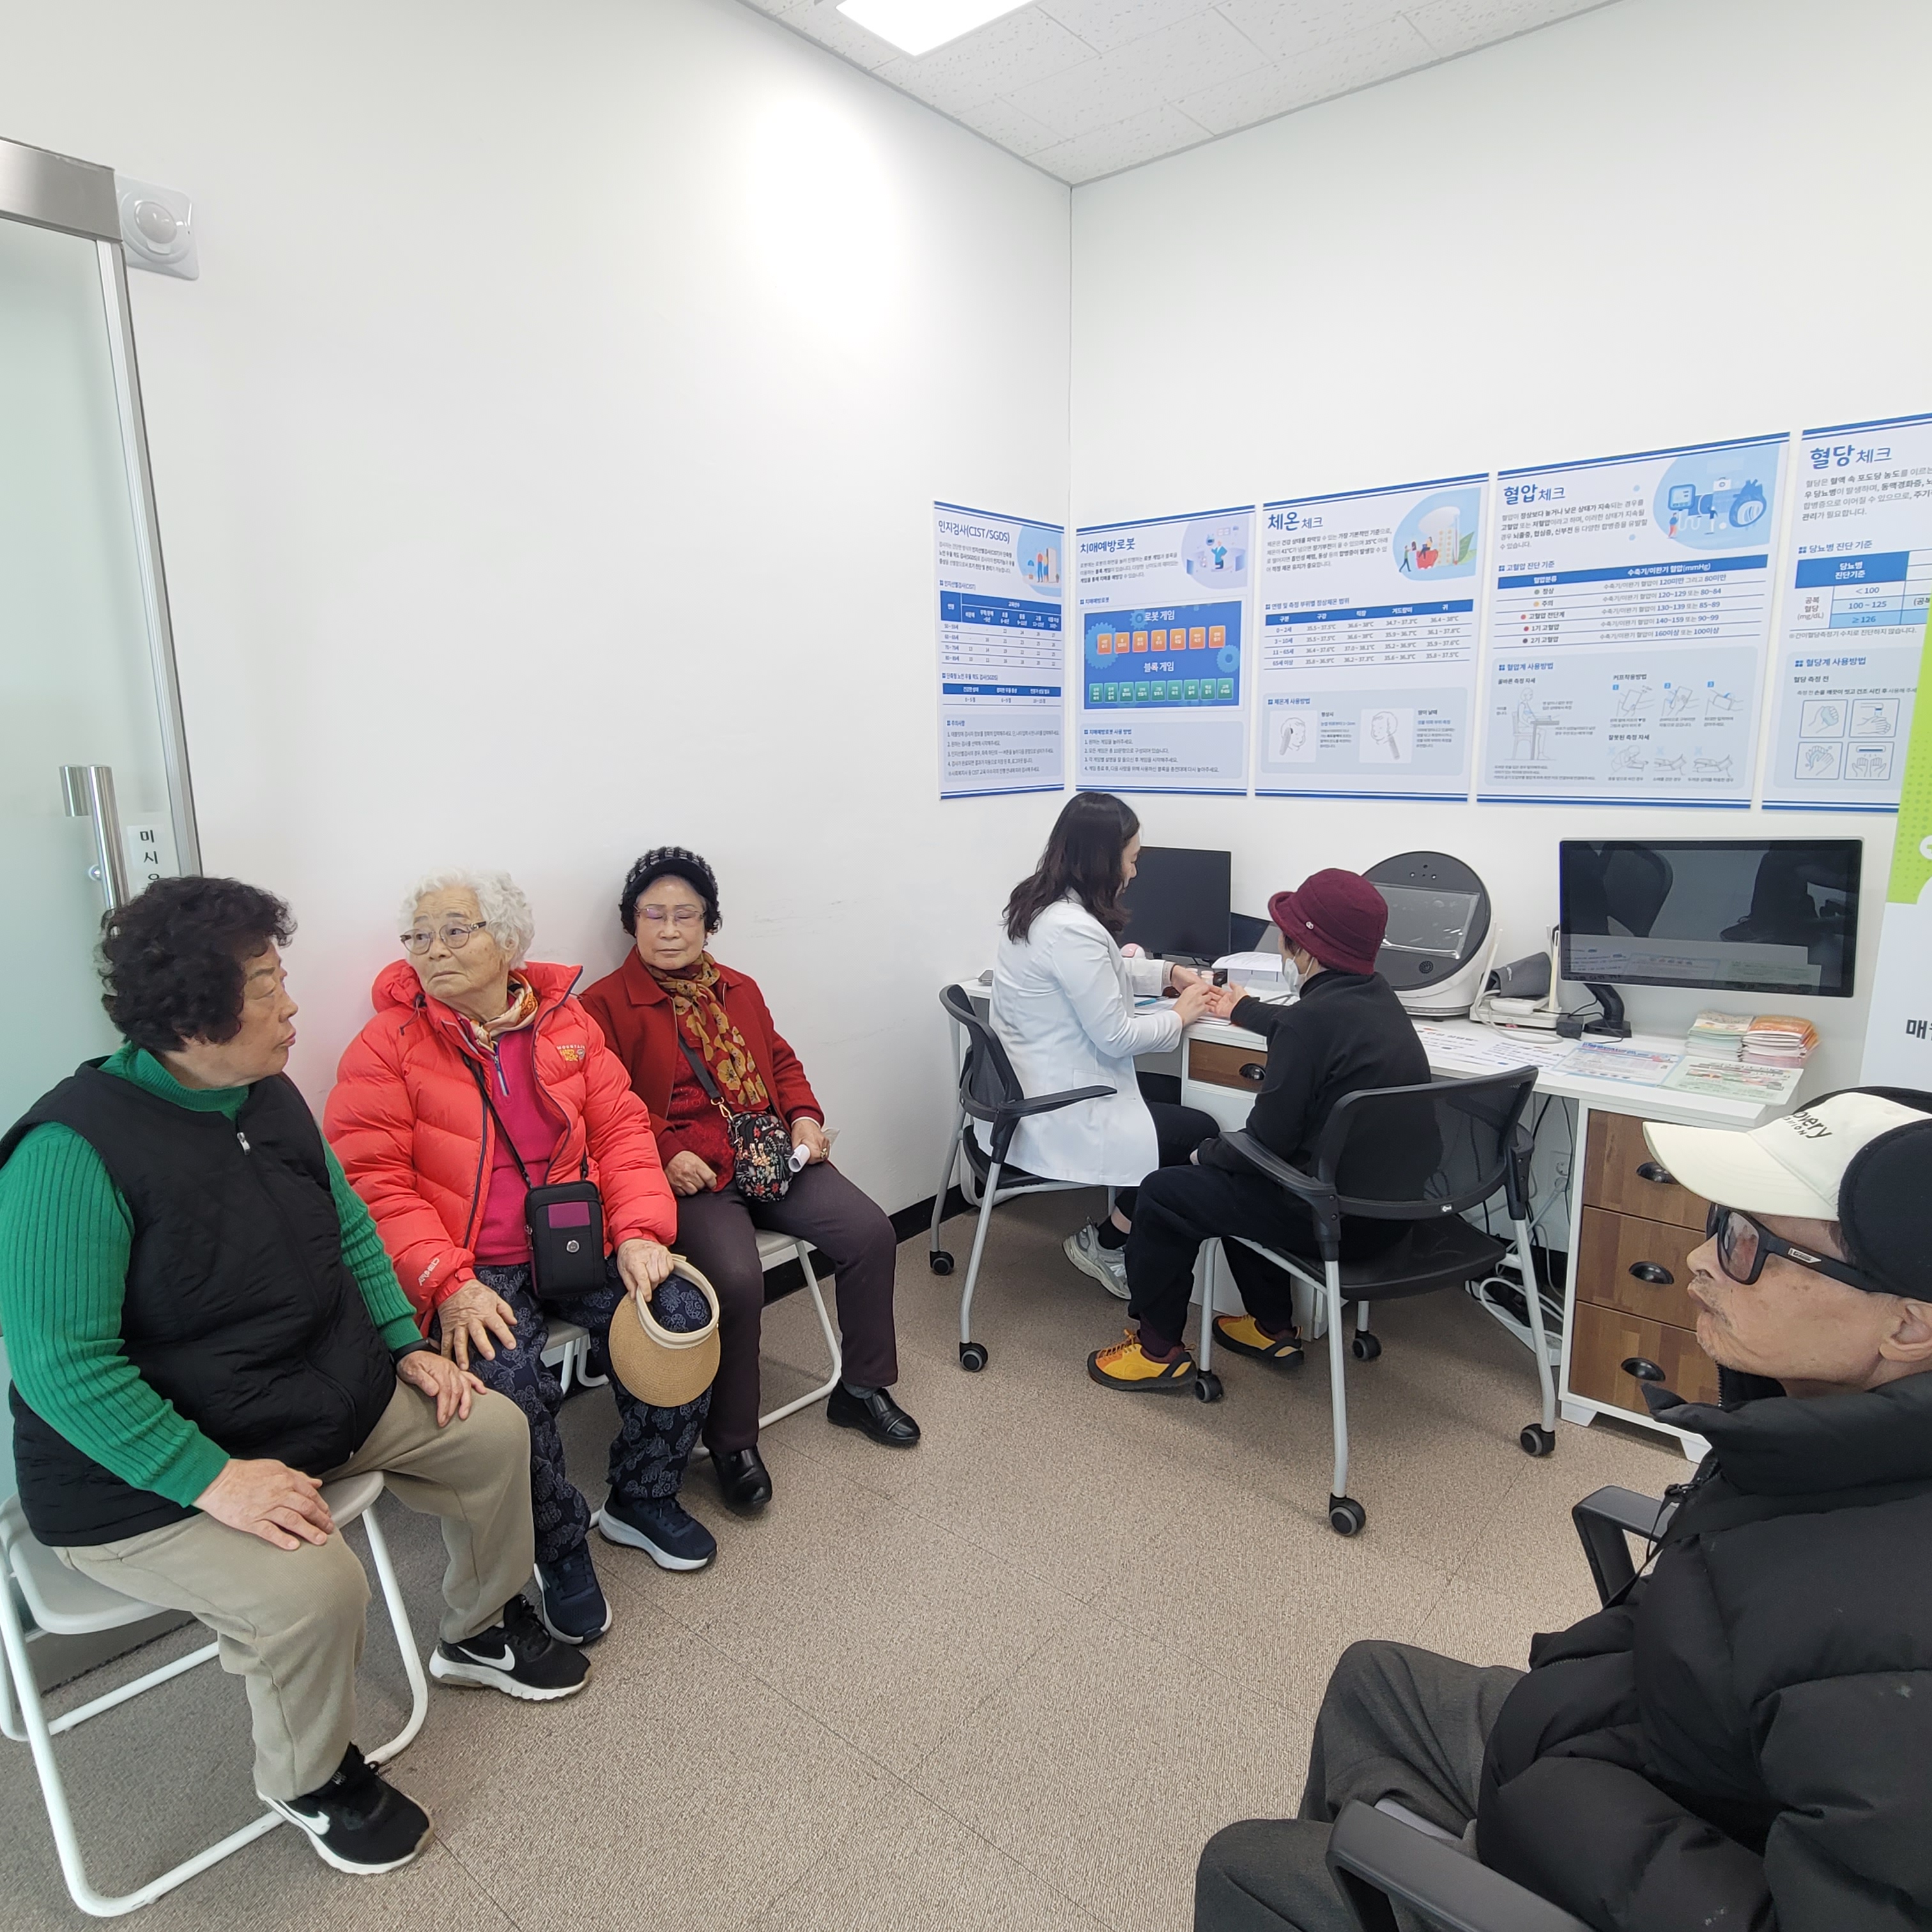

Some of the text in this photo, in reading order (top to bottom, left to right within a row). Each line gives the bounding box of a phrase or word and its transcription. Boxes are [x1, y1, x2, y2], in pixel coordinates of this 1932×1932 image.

[1811, 445, 1891, 470] 혈당 체크
[1806, 479, 1828, 488] 혈당은
[1830, 476, 1846, 485] 혈액
[1857, 472, 1882, 482] 포도당
[1884, 470, 1908, 479] 농도를
[1504, 484, 1565, 505] 혈압 체크
[1814, 488, 1844, 498] 당뇨병이
[1846, 484, 1879, 494] 발생하며,
[1882, 479, 1924, 491] 동맥경화증,
[1804, 500, 1841, 510] 합병증으로
[1843, 496, 1866, 505] 이어질
[1878, 492, 1912, 502] 있으므로,
[1521, 510, 1544, 519] 정상보다
[1545, 508, 1563, 516] 높거나
[1625, 499, 1643, 507] 경우를
[1802, 508, 1867, 521] 관리가 필요합니다.
[1267, 511, 1324, 532] 체온 체크
[1533, 518, 1568, 527] 저혈압이라고
[1605, 511, 1623, 520] 상태가
[939, 521, 1009, 544] 인지검사(CIST/SGDS)
[1080, 538, 1135, 553] 치매예방로봇
[1506, 541, 1531, 549] 있습니다.
[1809, 540, 1873, 553] 당뇨병 진단 기준
[1528, 562, 1540, 570] 진단
[1628, 564, 1710, 576] 수축기/이완기 혈압(mmHg)
[1840, 562, 1862, 571] 당뇨병
[1534, 576, 1556, 584] 혈압분류
[1705, 574, 1726, 582] 80미만
[1836, 570, 1865, 579] 진단기준
[1144, 610, 1174, 621] 로봇 게임
[1797, 612, 1824, 620] (mg/dL)
[1144, 661, 1174, 673] 블록 게임
[1806, 657, 1866, 667] 혈당계 사용방법
[1906, 1019, 1932, 1041] 매
